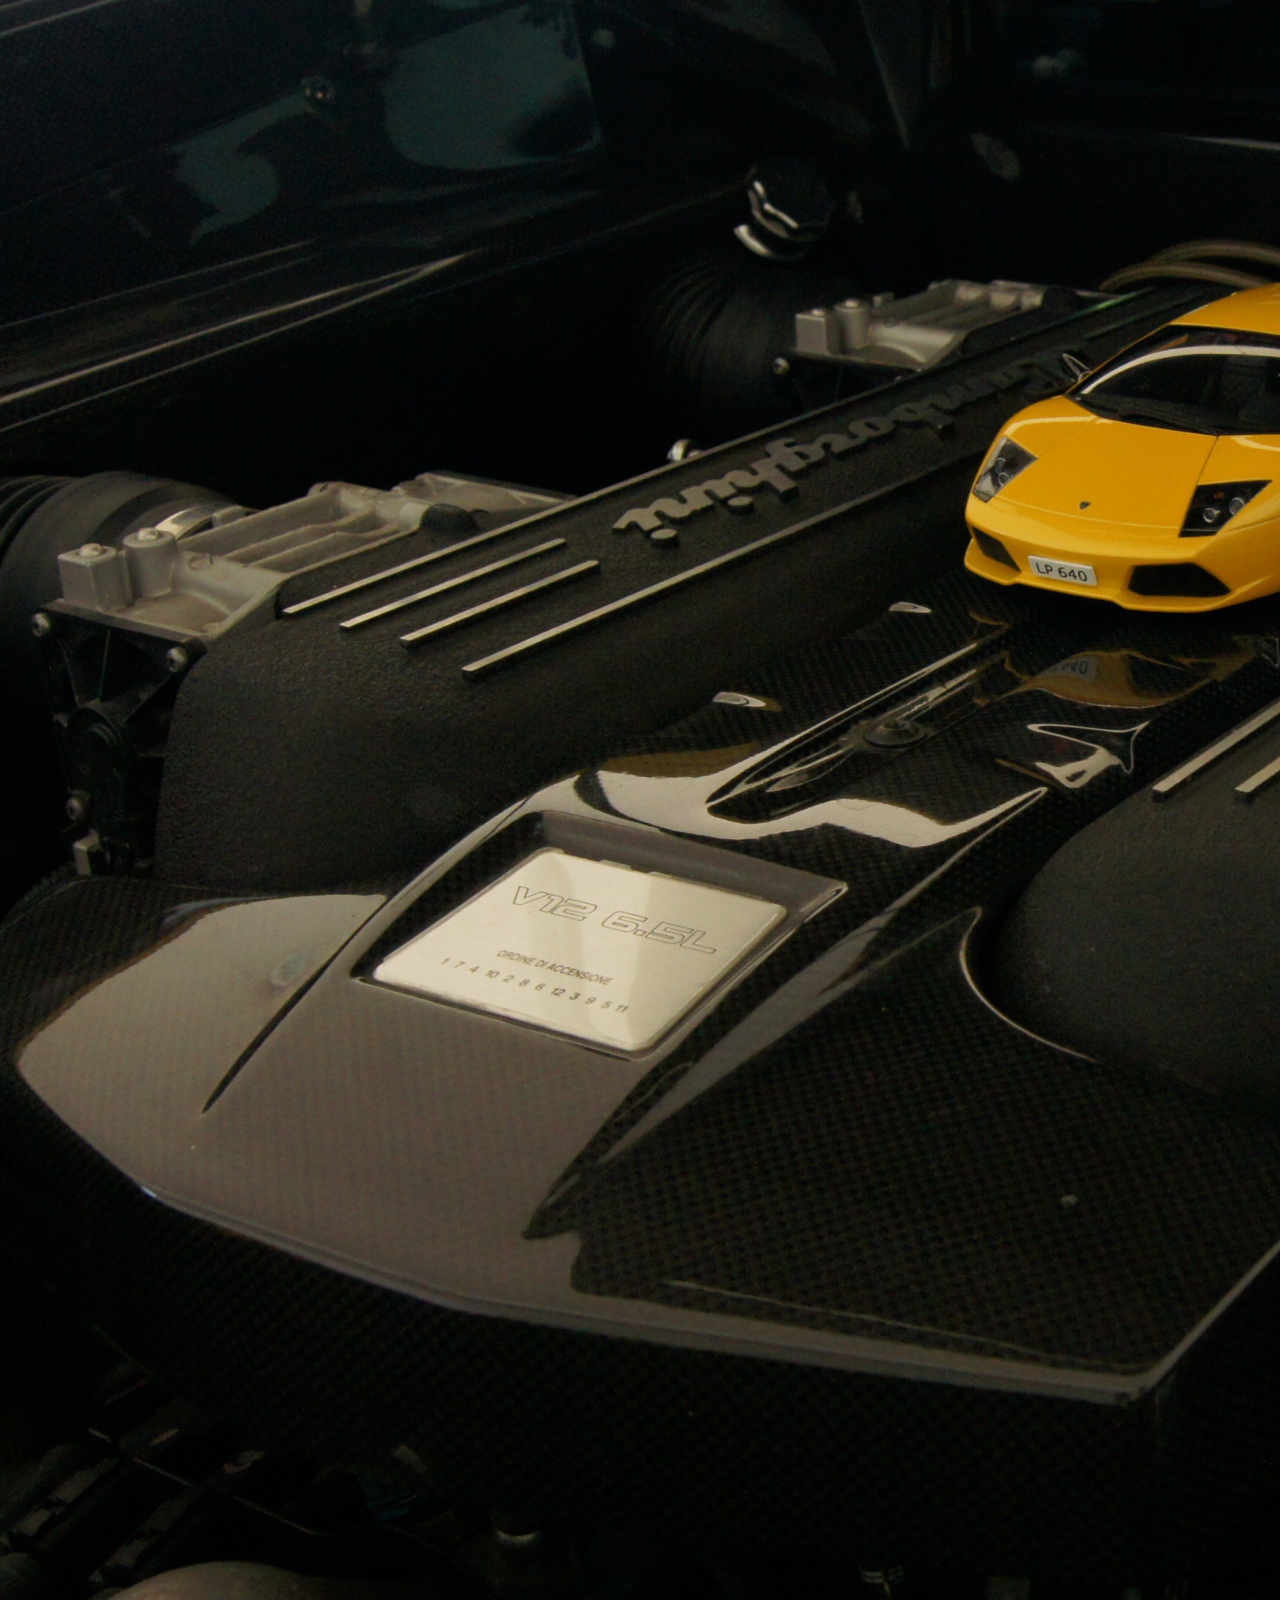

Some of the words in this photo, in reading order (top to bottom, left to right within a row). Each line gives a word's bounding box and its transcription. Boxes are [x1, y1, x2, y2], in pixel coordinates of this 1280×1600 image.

[1035, 562, 1053, 575] LP
[1058, 567, 1087, 582] 640
[512, 885, 598, 922] V12
[601, 910, 718, 955] 6.5L
[454, 960, 465, 969] 7
[469, 965, 480, 974] 4
[484, 969, 500, 979] 10
[502, 974, 514, 983] 2
[518, 978, 530, 987] 8
[534, 982, 546, 991] 6
[550, 986, 566, 997] 12
[569, 991, 581, 1001] 3
[584, 996, 597, 1005] 9
[600, 1000, 613, 1010] 5
[614, 1003, 629, 1013] 11
[497, 949, 536, 967] ORDINE
[534, 959, 548, 968] DI
[547, 962, 613, 986] ACCENSIONE
